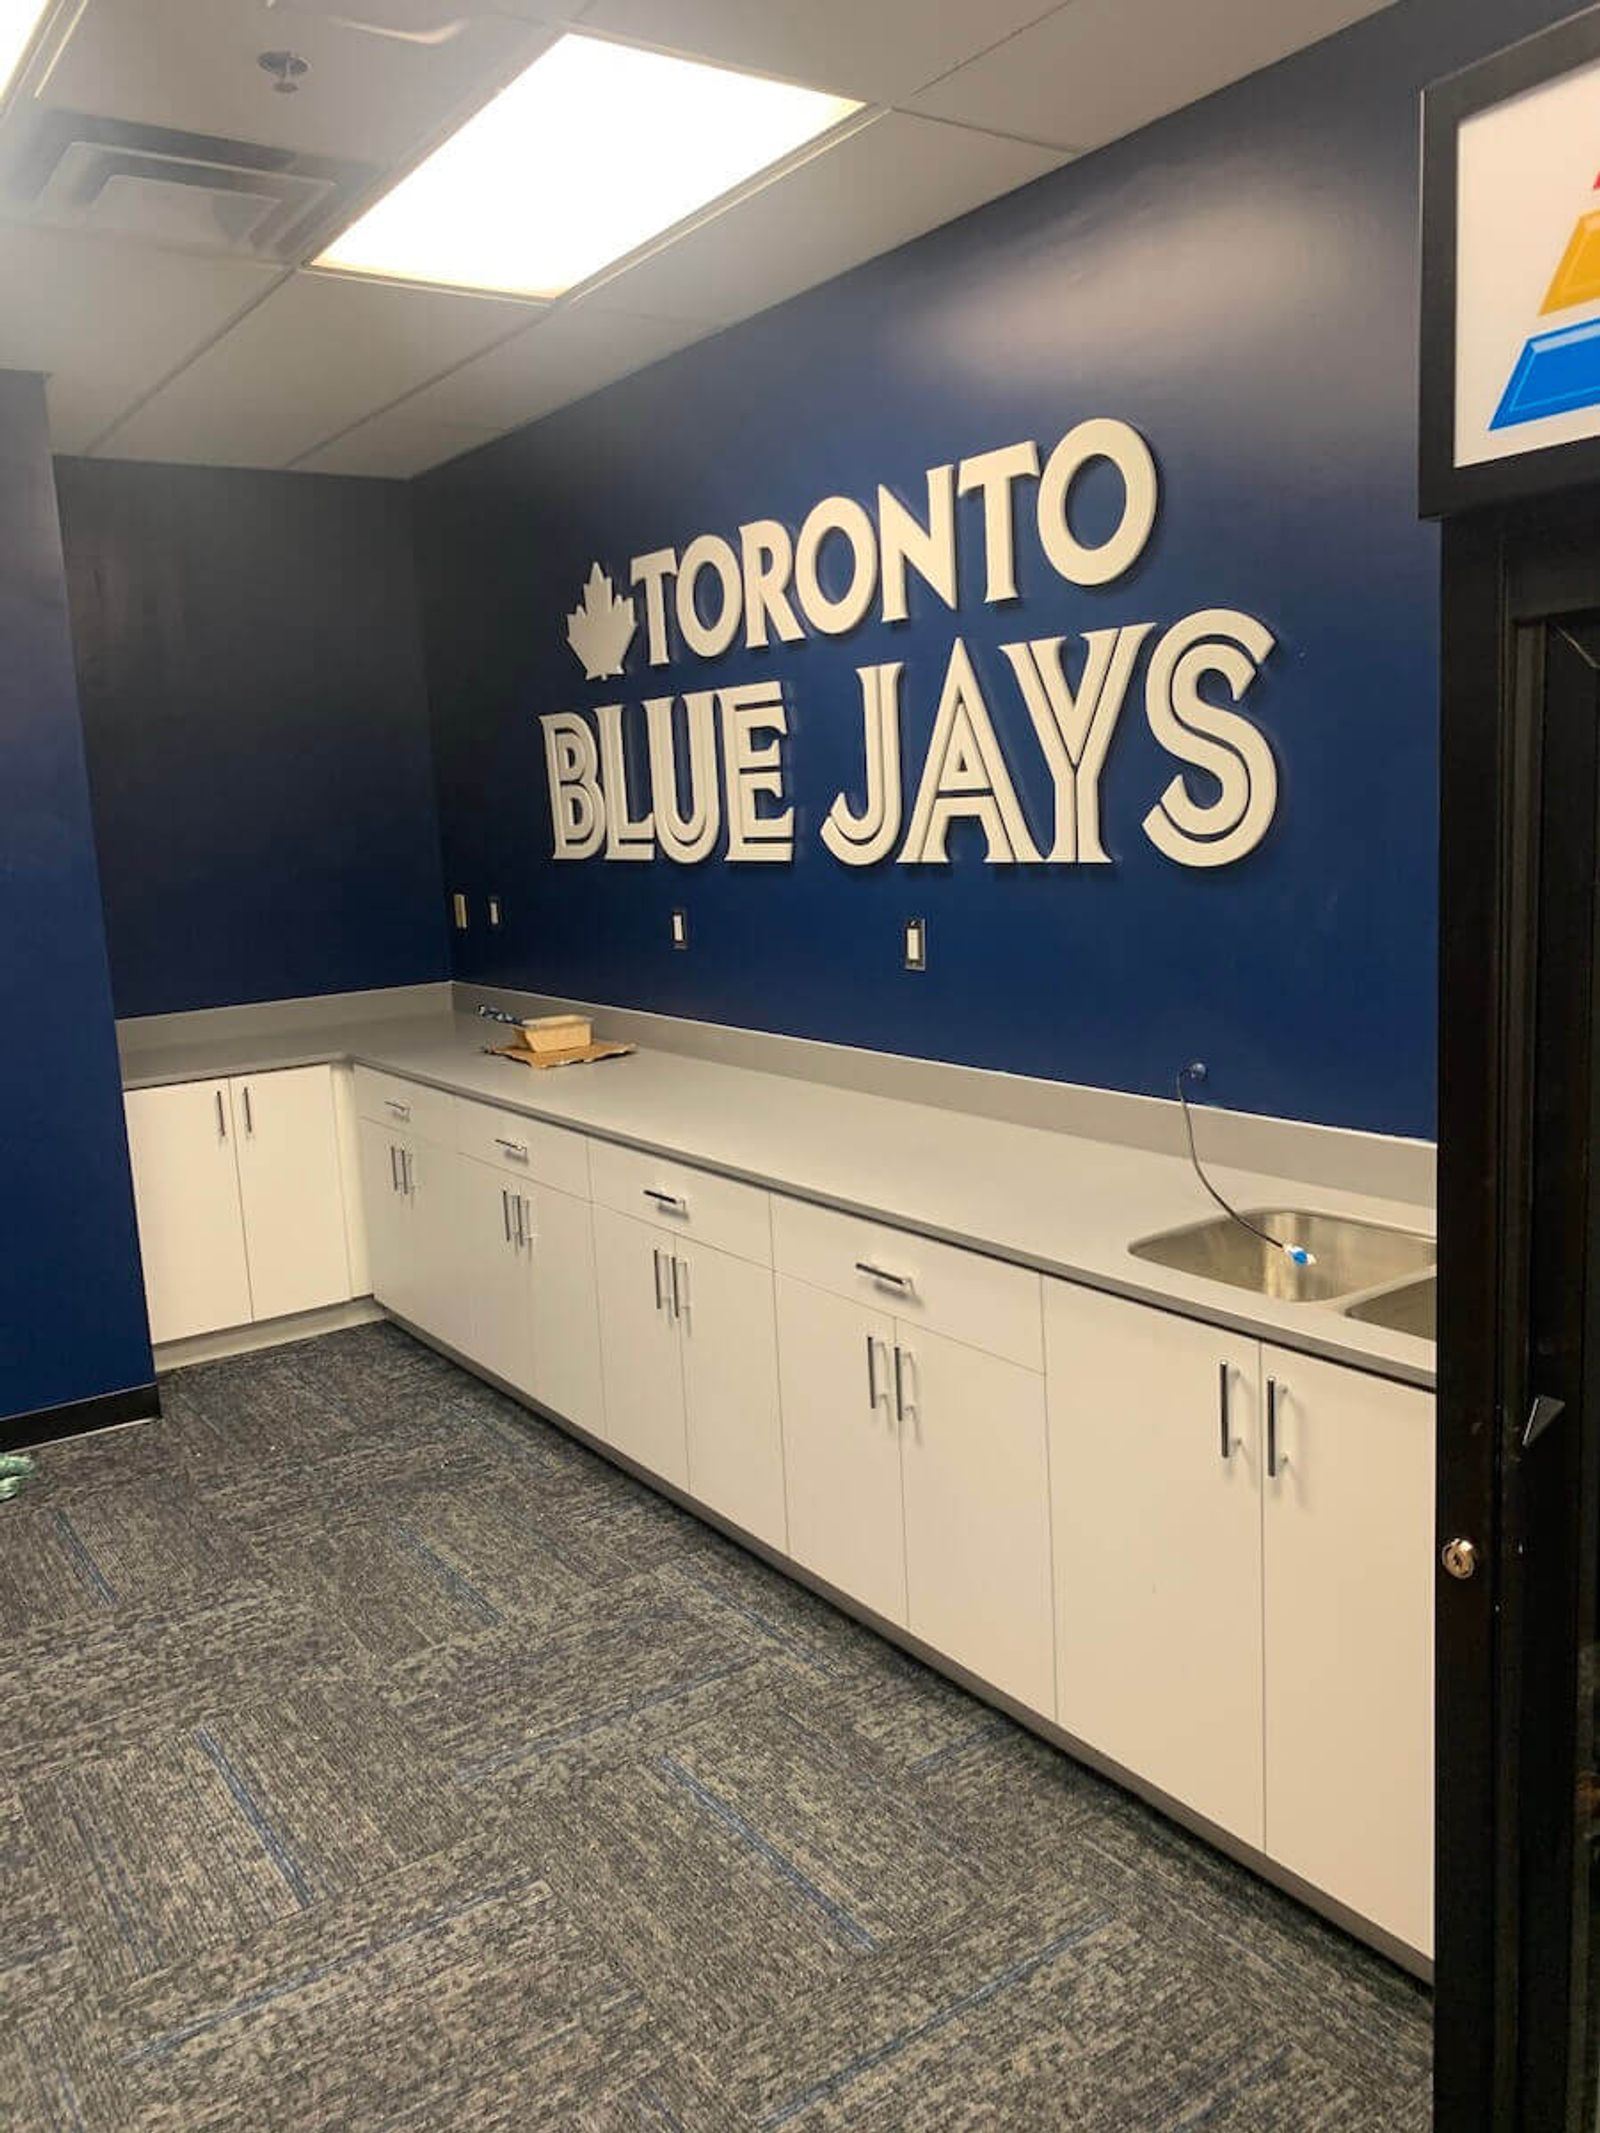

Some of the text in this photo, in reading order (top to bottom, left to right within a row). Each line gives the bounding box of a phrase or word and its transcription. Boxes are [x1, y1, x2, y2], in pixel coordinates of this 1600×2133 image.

[630, 418, 1158, 667] TORONTO
[539, 608, 1278, 868] BLUE JAYS
